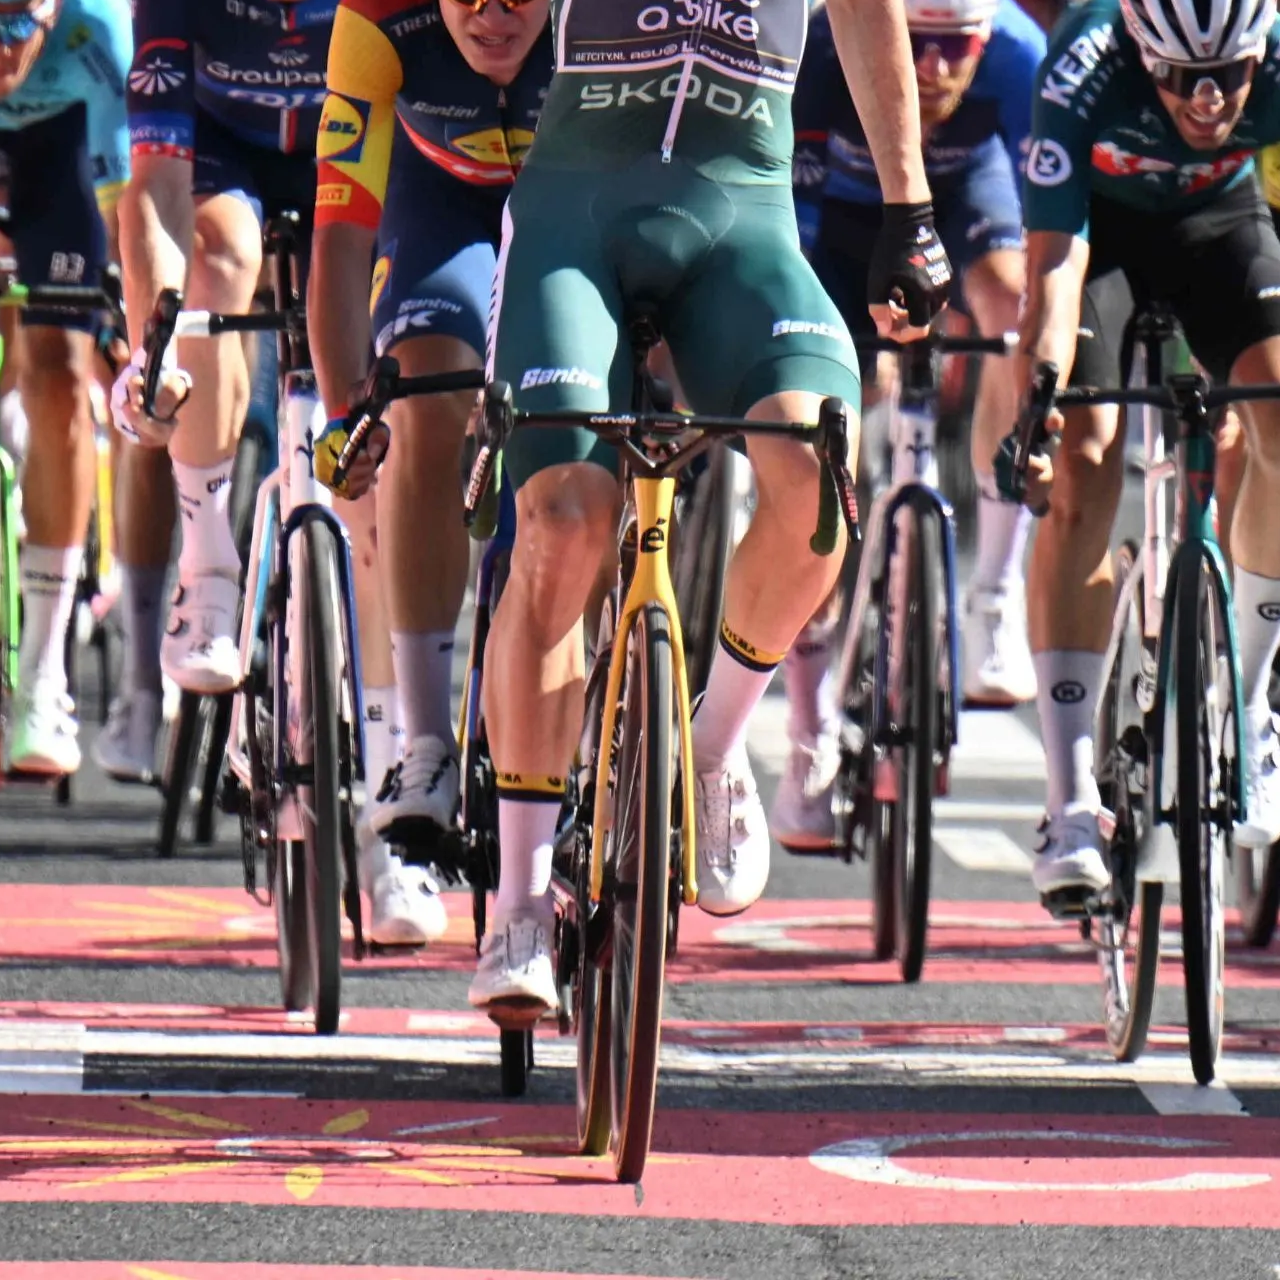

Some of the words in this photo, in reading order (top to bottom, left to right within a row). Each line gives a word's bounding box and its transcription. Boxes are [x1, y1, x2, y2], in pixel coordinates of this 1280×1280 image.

[637, 6, 670, 32] a
[206, 59, 327, 88] Groupa
[1040, 22, 1119, 110] KERN
[412, 101, 481, 119] Santini
[579, 73, 774, 128] SKODA
[399, 298, 462, 315] Santini
